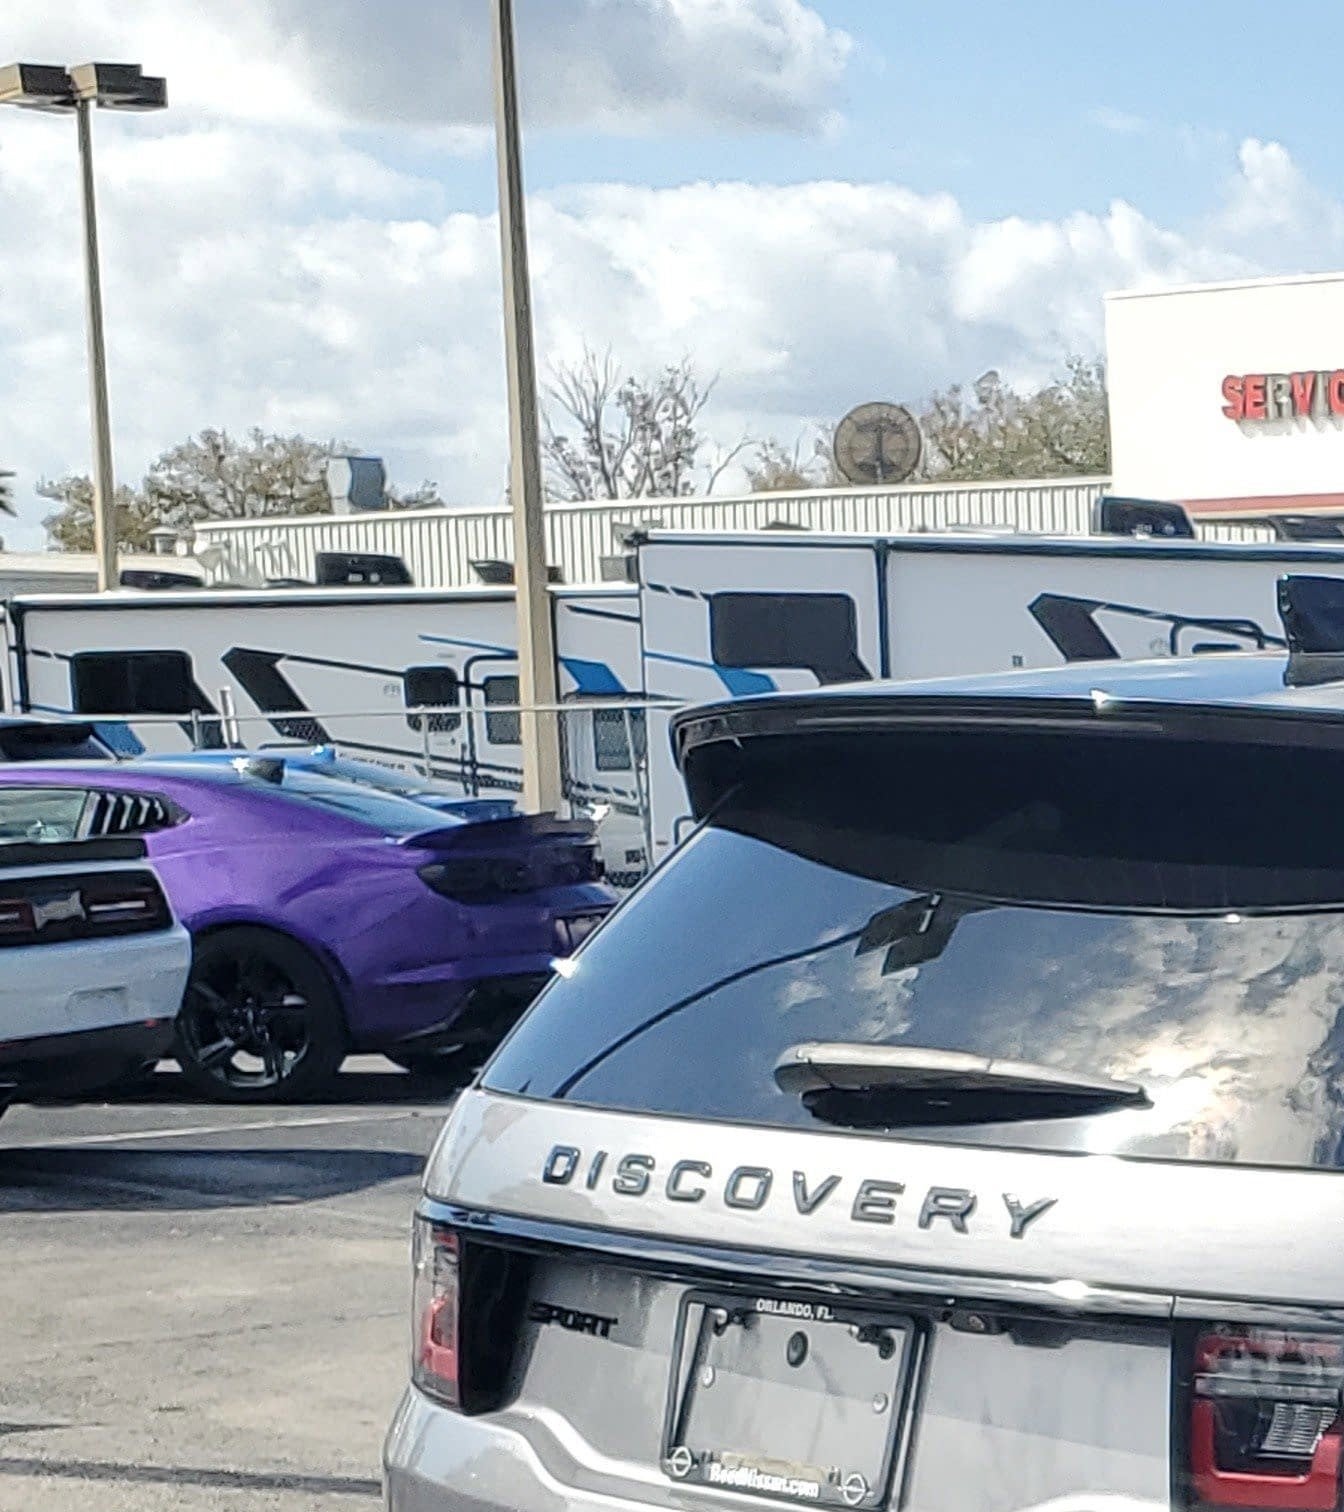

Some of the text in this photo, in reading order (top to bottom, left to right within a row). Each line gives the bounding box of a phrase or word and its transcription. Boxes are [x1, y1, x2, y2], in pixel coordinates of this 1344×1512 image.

[543, 1144, 1058, 1239] DISCOVERY
[529, 1301, 619, 1340] SPORT
[756, 1298, 815, 1320] ORLANDO,
